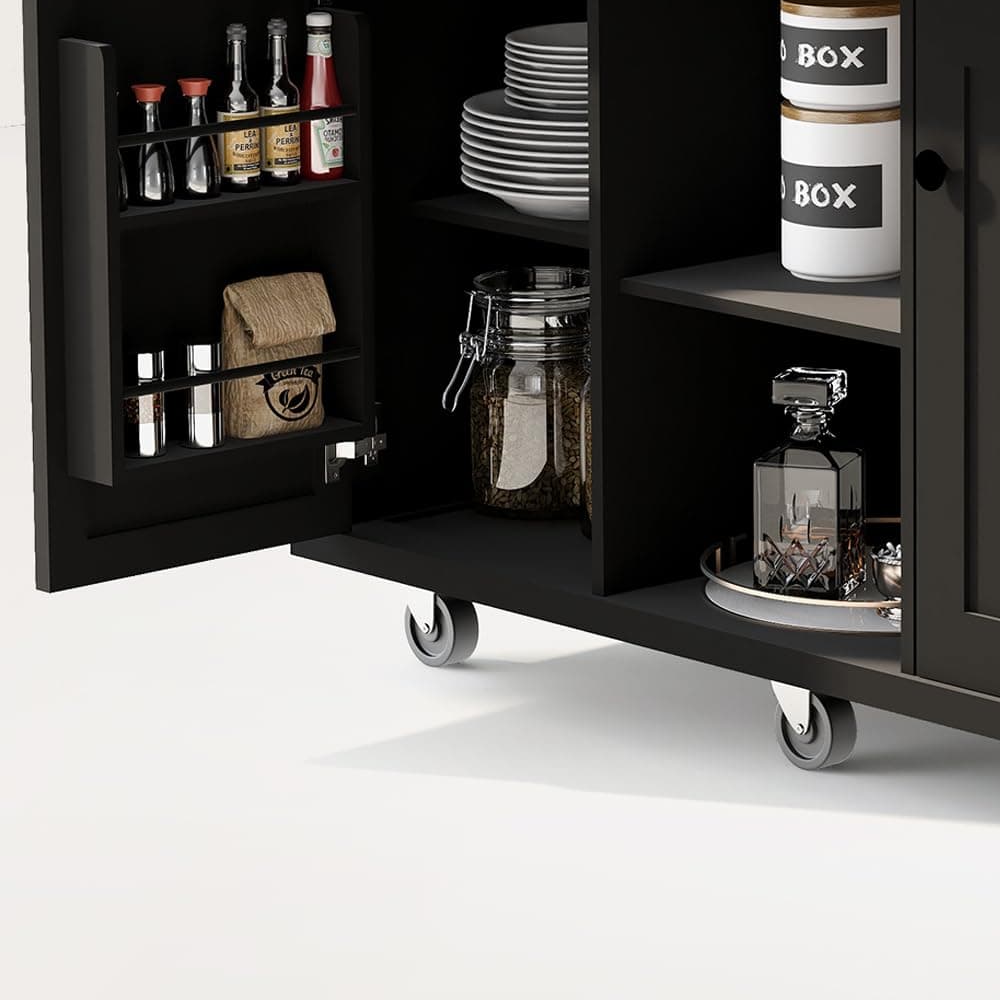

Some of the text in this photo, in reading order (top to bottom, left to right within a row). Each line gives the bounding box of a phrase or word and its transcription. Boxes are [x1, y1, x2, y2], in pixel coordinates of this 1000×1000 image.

[798, 43, 865, 69] BOX
[244, 130, 256, 138] LEA
[284, 124, 297, 132] LEA
[794, 180, 857, 209] BOX
